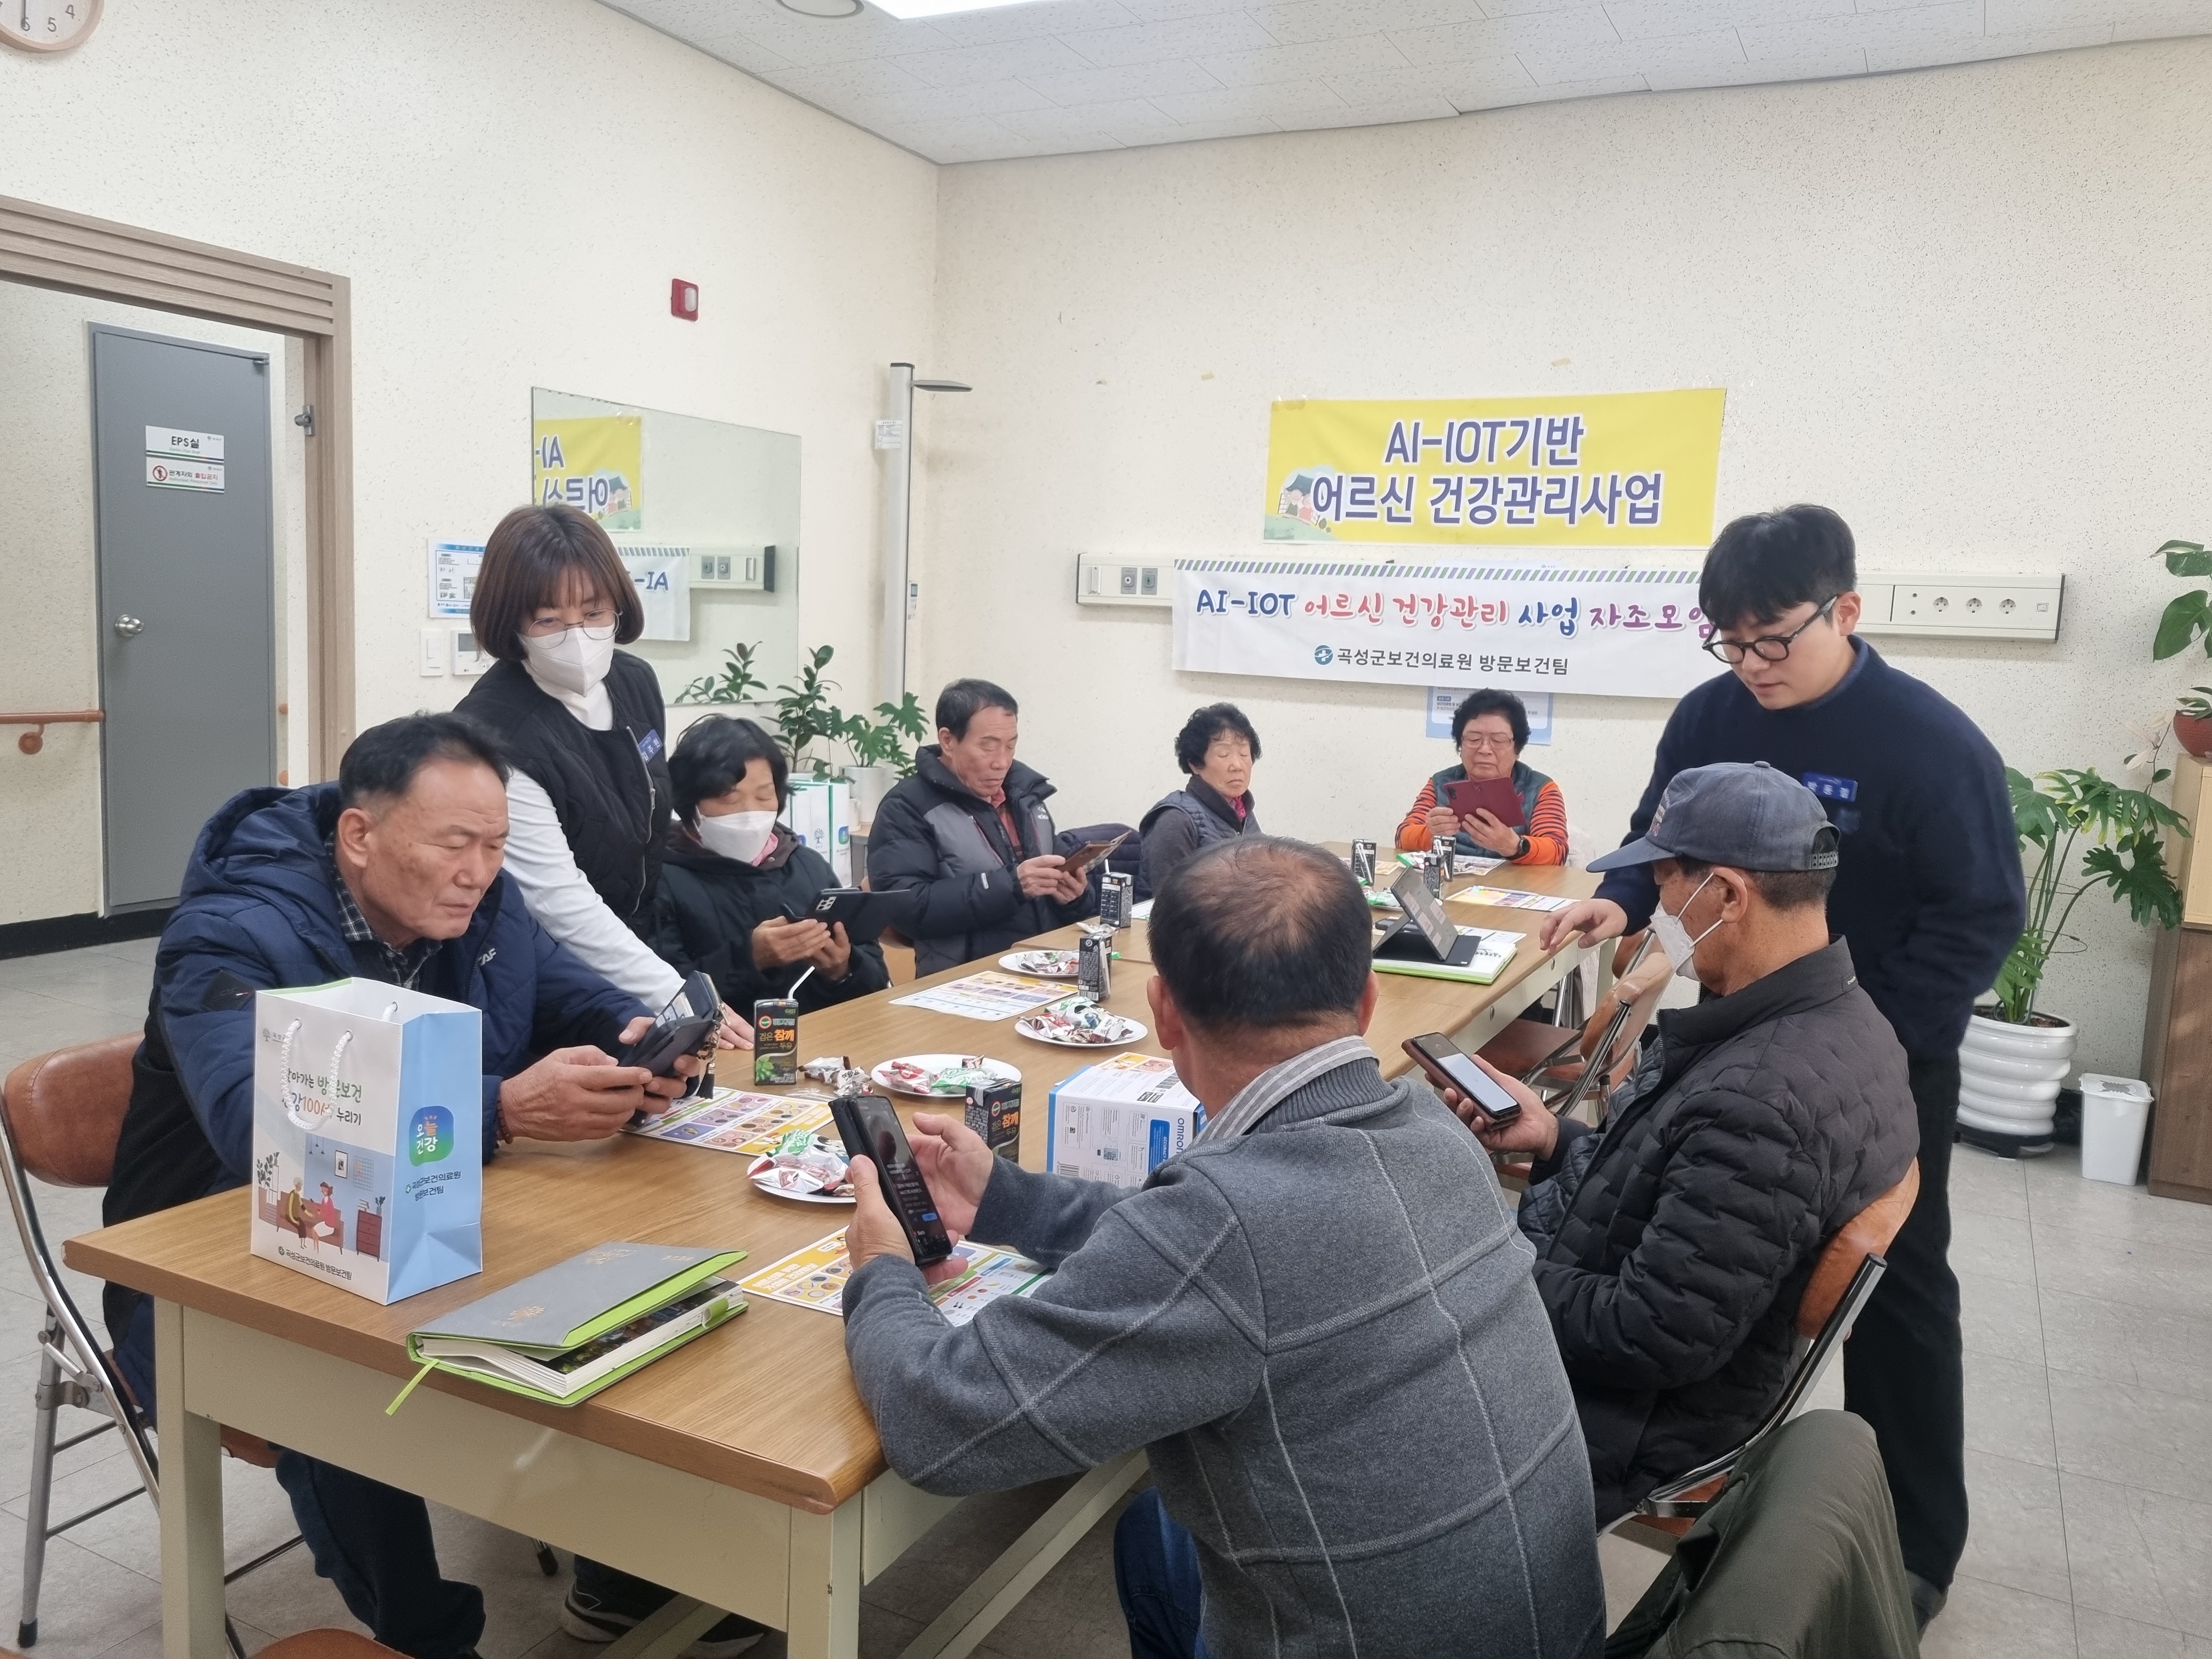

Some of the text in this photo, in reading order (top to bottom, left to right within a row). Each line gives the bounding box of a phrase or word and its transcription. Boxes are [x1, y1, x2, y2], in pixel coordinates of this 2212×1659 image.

[65, 4, 76, 20] 4
[47, 16, 57, 32] 5
[171, 436, 200, 449] EPS실
[1384, 415, 1585, 467] AI-IOT기반
[1314, 473, 1662, 525] 어르신 건강관리사업
[1197, 589, 1296, 616] AI-IOT
[1304, 592, 1384, 623] 어르신
[1392, 593, 1506, 628] 건강관리
[1518, 596, 1578, 636] 사업
[1337, 648, 1568, 675] 곡성군보건의료원 방문보건팀
[774, 1029, 795, 1042] 참깨
[336, 1107, 362, 1126] 누리기
[417, 1136, 439, 1155] 건강
[286, 1249, 353, 1280] 곡성군보건의료원 방문보건팀
